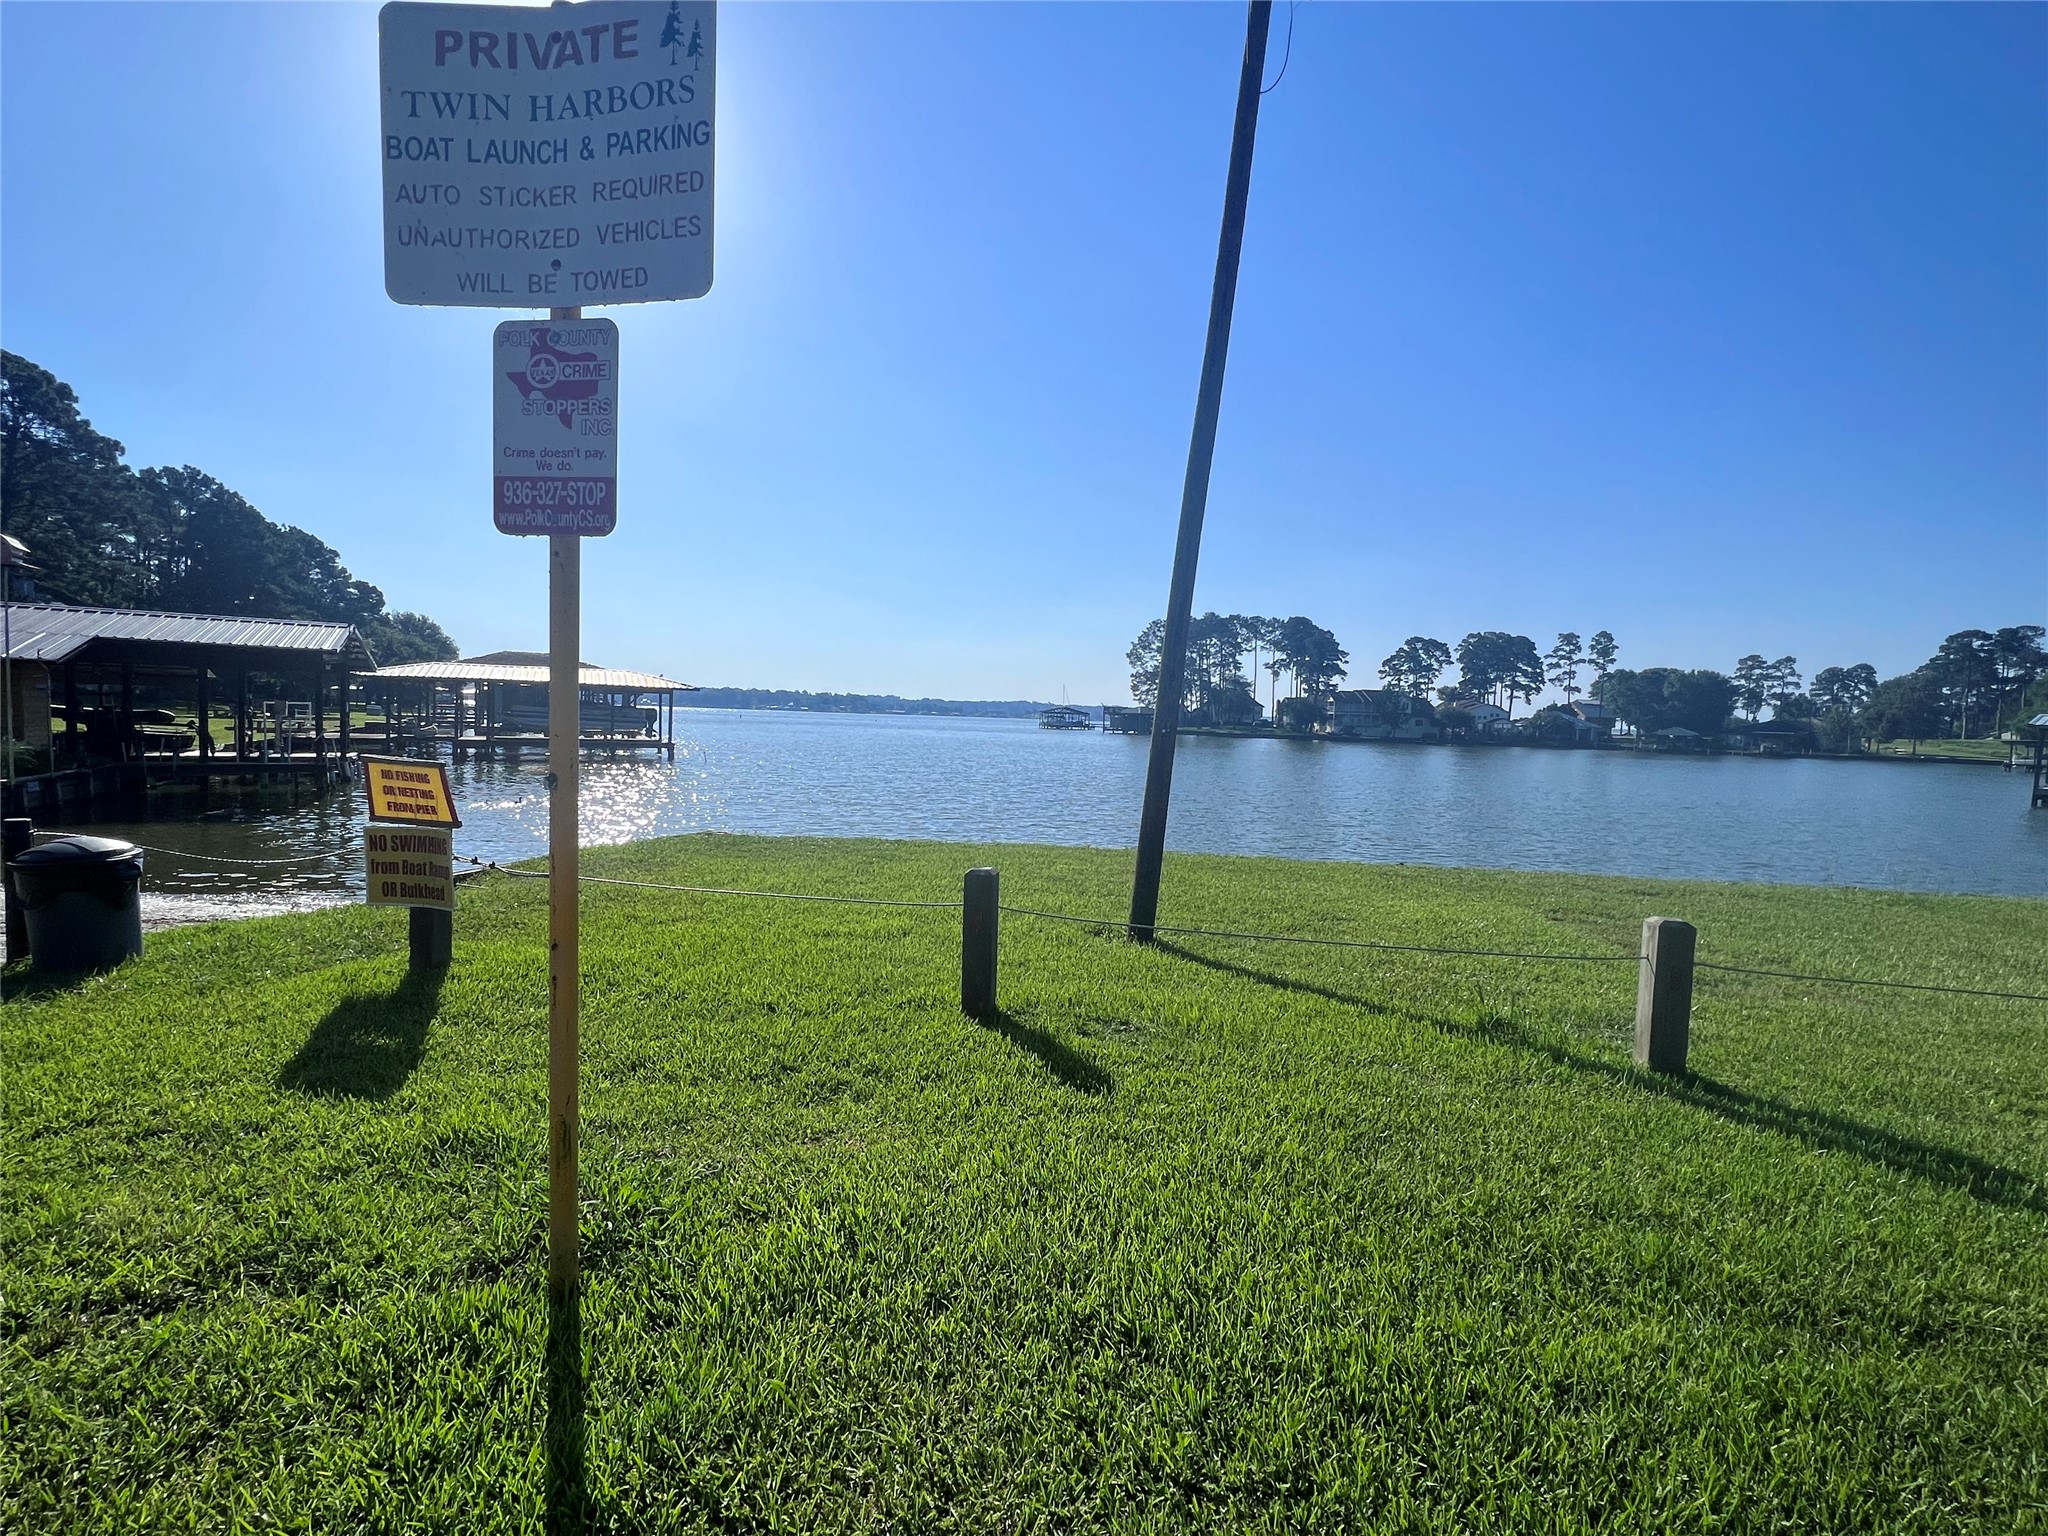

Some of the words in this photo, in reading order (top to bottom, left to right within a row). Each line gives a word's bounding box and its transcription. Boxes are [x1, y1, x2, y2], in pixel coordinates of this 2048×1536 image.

[434, 19, 640, 70] PRIVATE
[401, 90, 511, 121] TWIN
[528, 75, 696, 122] HARBORS
[386, 135, 454, 162] BOAT
[467, 137, 568, 164] LAUNCH
[579, 136, 595, 161] &
[607, 120, 710, 158] PARKING
[395, 183, 460, 205] AUTO
[480, 184, 576, 207] STICKER
[593, 170, 704, 203] REQUIRED
[398, 224, 580, 250] UNAUTHORIZED
[596, 215, 701, 246] VEHICLES
[457, 271, 513, 294] WILL
[528, 272, 557, 294] BE
[570, 266, 649, 293] TOWED
[499, 329, 541, 347] POLK
[561, 361, 607, 379] CRIME
[521, 398, 612, 416] STOPPERS
[581, 418, 612, 436] INC
[504, 446, 535, 458] Crime
[540, 446, 581, 458] doesn't
[585, 448, 607, 461] pay.
[536, 459, 555, 471] We
[557, 460, 574, 471] do.
[503, 480, 606, 506] 936-327-STOP
[499, 509, 611, 531] www.PolkCuntyCS.org
[381, 768, 394, 780] NO
[395, 770, 430, 784] FISHING
[382, 785, 396, 796] OR
[398, 786, 435, 800] NETTING
[387, 801, 415, 814] FROM
[416, 804, 438, 816] PIER
[369, 834, 387, 852] NO
[391, 834, 447, 857] SWIMMING
[370, 859, 399, 875] from
[402, 859, 427, 876] Boat
[429, 861, 450, 881] Ramp
[381, 881, 397, 897] OR
[400, 882, 445, 901] Bulkhead
